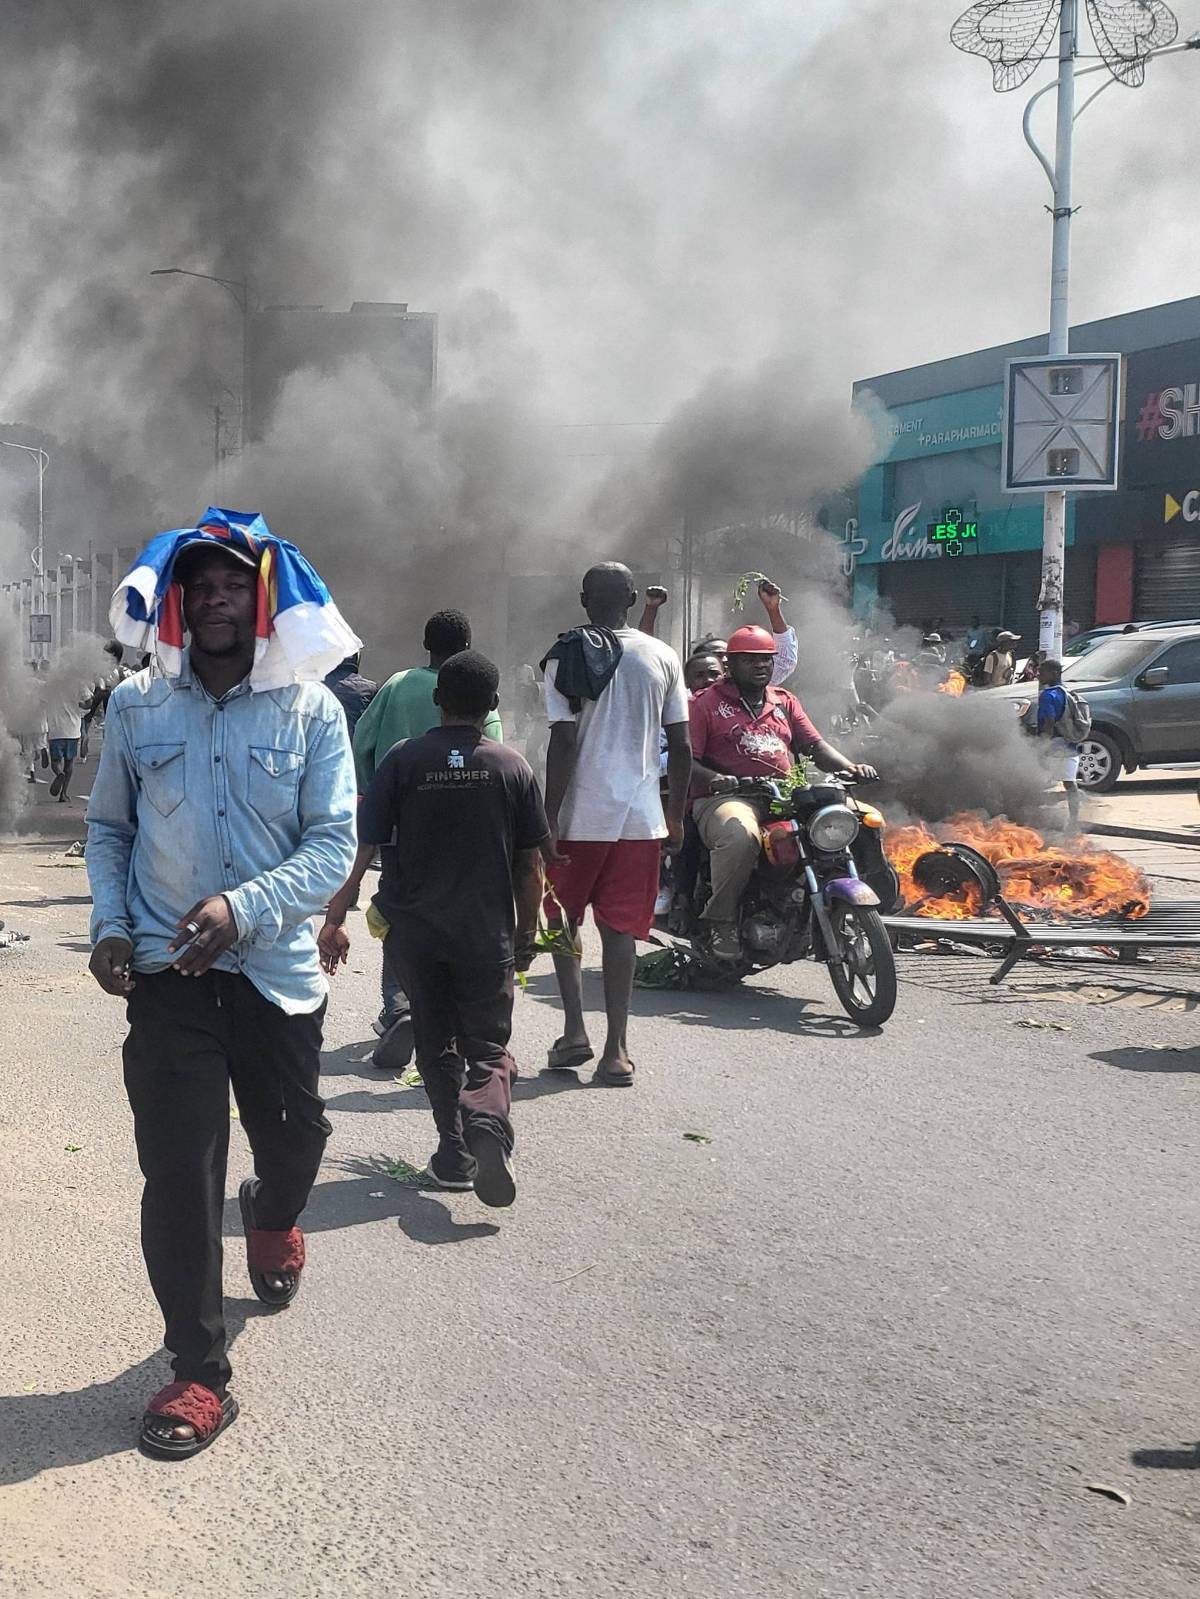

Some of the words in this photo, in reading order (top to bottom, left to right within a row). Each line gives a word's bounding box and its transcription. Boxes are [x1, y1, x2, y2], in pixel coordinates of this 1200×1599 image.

[1182, 490, 1200, 522] C
[932, 524, 957, 540] ES
[425, 770, 490, 782] FINISHER
